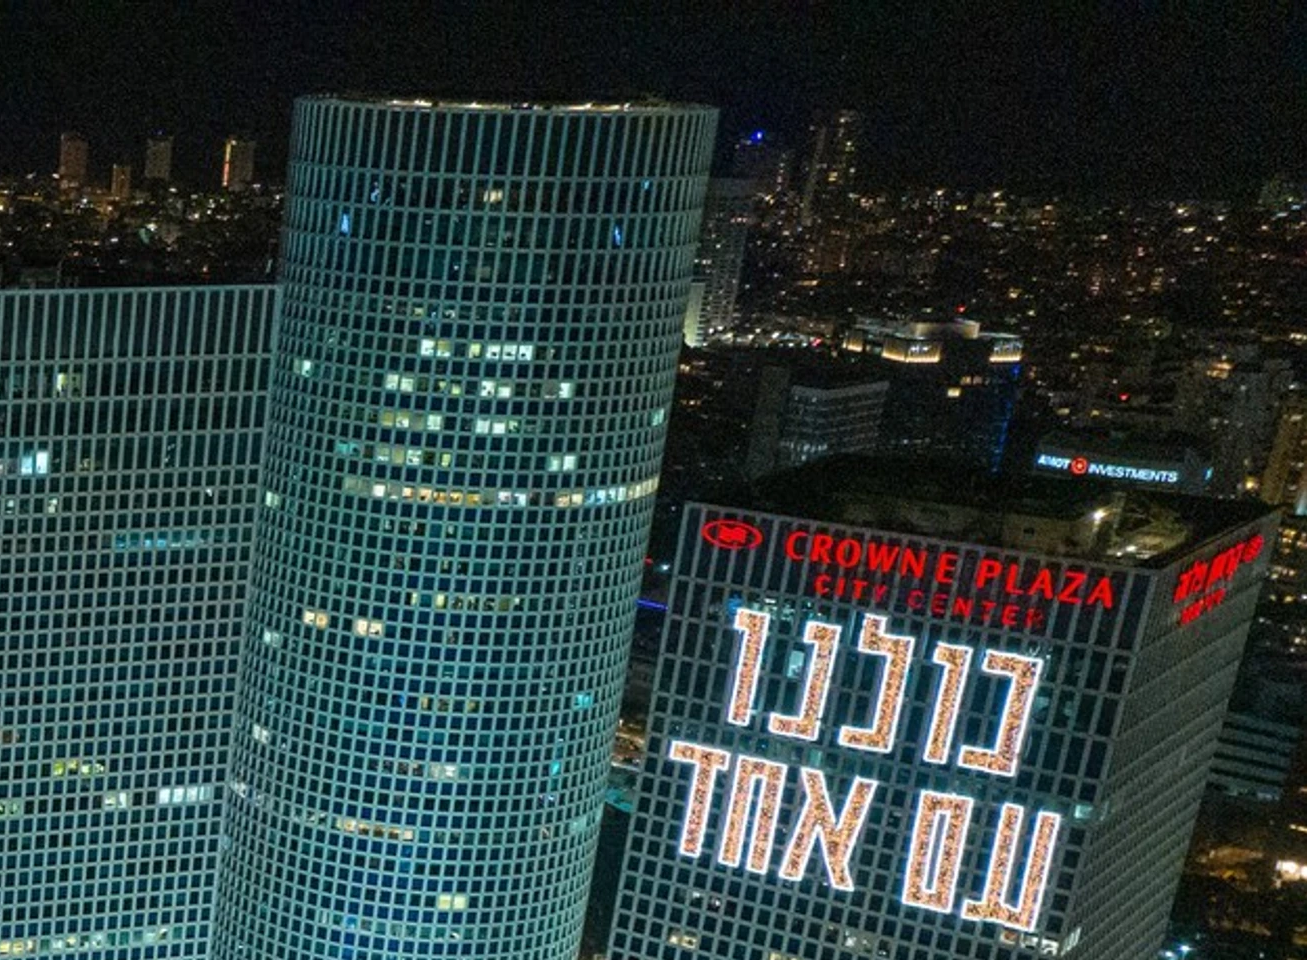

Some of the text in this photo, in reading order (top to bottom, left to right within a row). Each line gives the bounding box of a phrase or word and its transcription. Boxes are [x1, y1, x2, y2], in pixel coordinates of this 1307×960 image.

[1087, 462, 1179, 483] INVESTMENTS
[784, 530, 958, 585] CROWNE
[975, 557, 1115, 610] PLAZA
[813, 573, 1044, 628] CITY CENTER
[727, 608, 1044, 777] כולנו
[669, 739, 1062, 933] עם אחד
